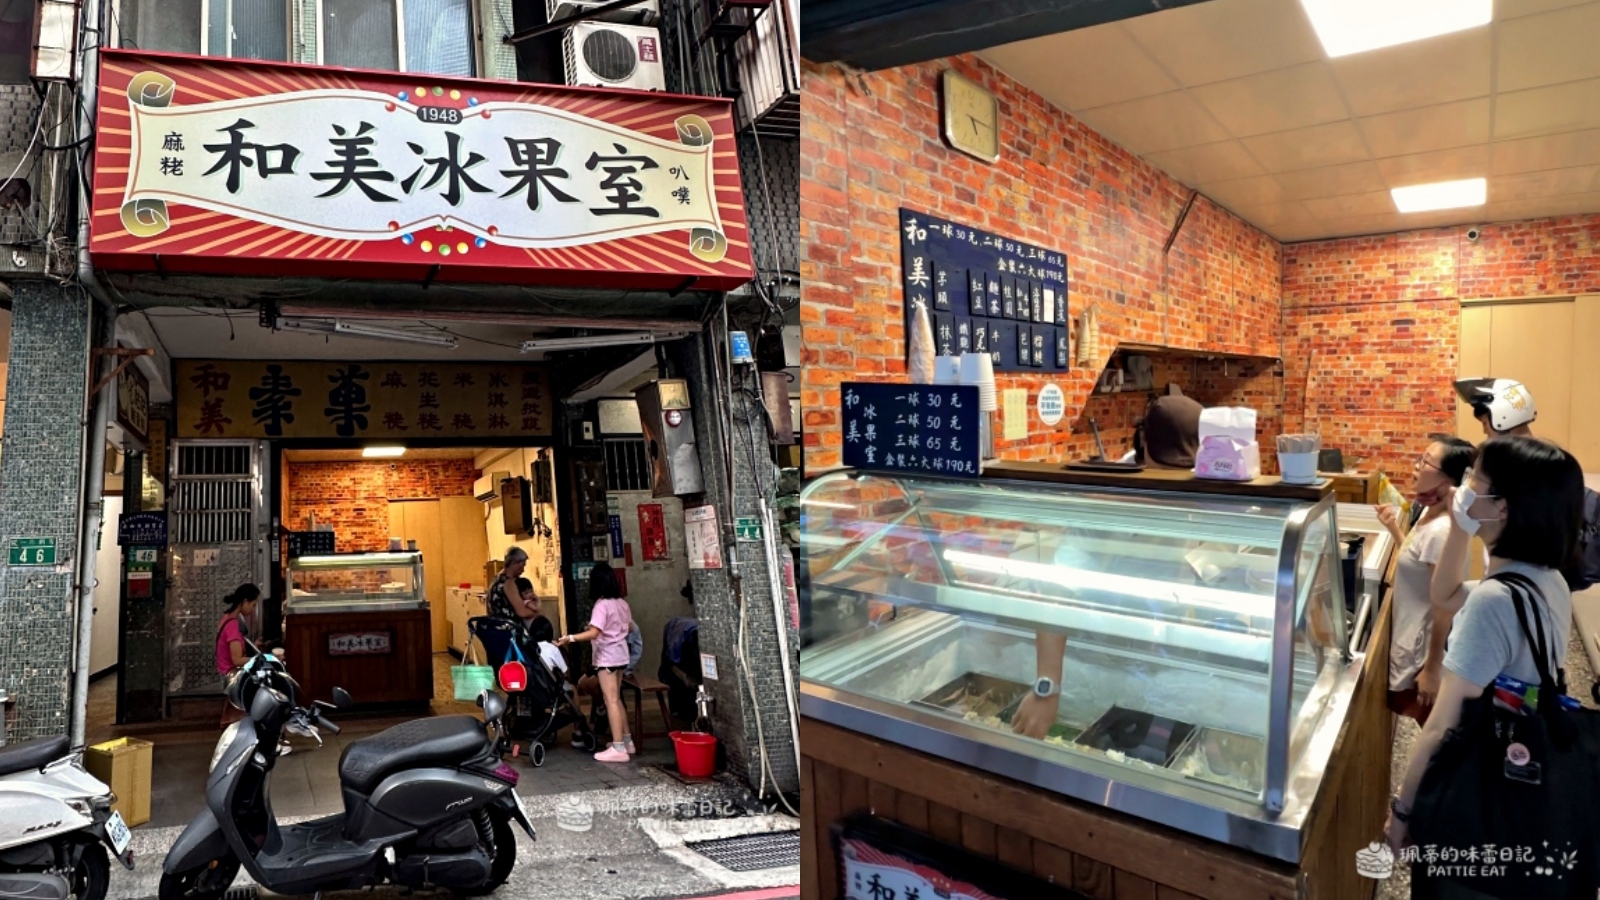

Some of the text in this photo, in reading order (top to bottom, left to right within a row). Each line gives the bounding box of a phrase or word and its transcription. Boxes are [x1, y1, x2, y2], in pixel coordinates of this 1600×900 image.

[420, 106, 459, 123] 1948
[201, 118, 662, 219] 和美冰果室
[668, 165, 692, 206] 叭噗
[937, 270, 949, 305] 芋頭
[972, 278, 984, 310] 紅豆
[988, 279, 1000, 315] 麵茶
[939, 323, 953, 357] 抹茶
[958, 321, 970, 354] 鐵觀
[975, 327, 986, 354] 巧克
[189, 362, 233, 435] 和美
[488, 371, 510, 430] 冰淇淋
[844, 388, 862, 443] 和美
[863, 403, 878, 463] 冰果室
[884, 451, 976, 474] 盒裝六大球190元
[19, 547, 45, 563] 46
